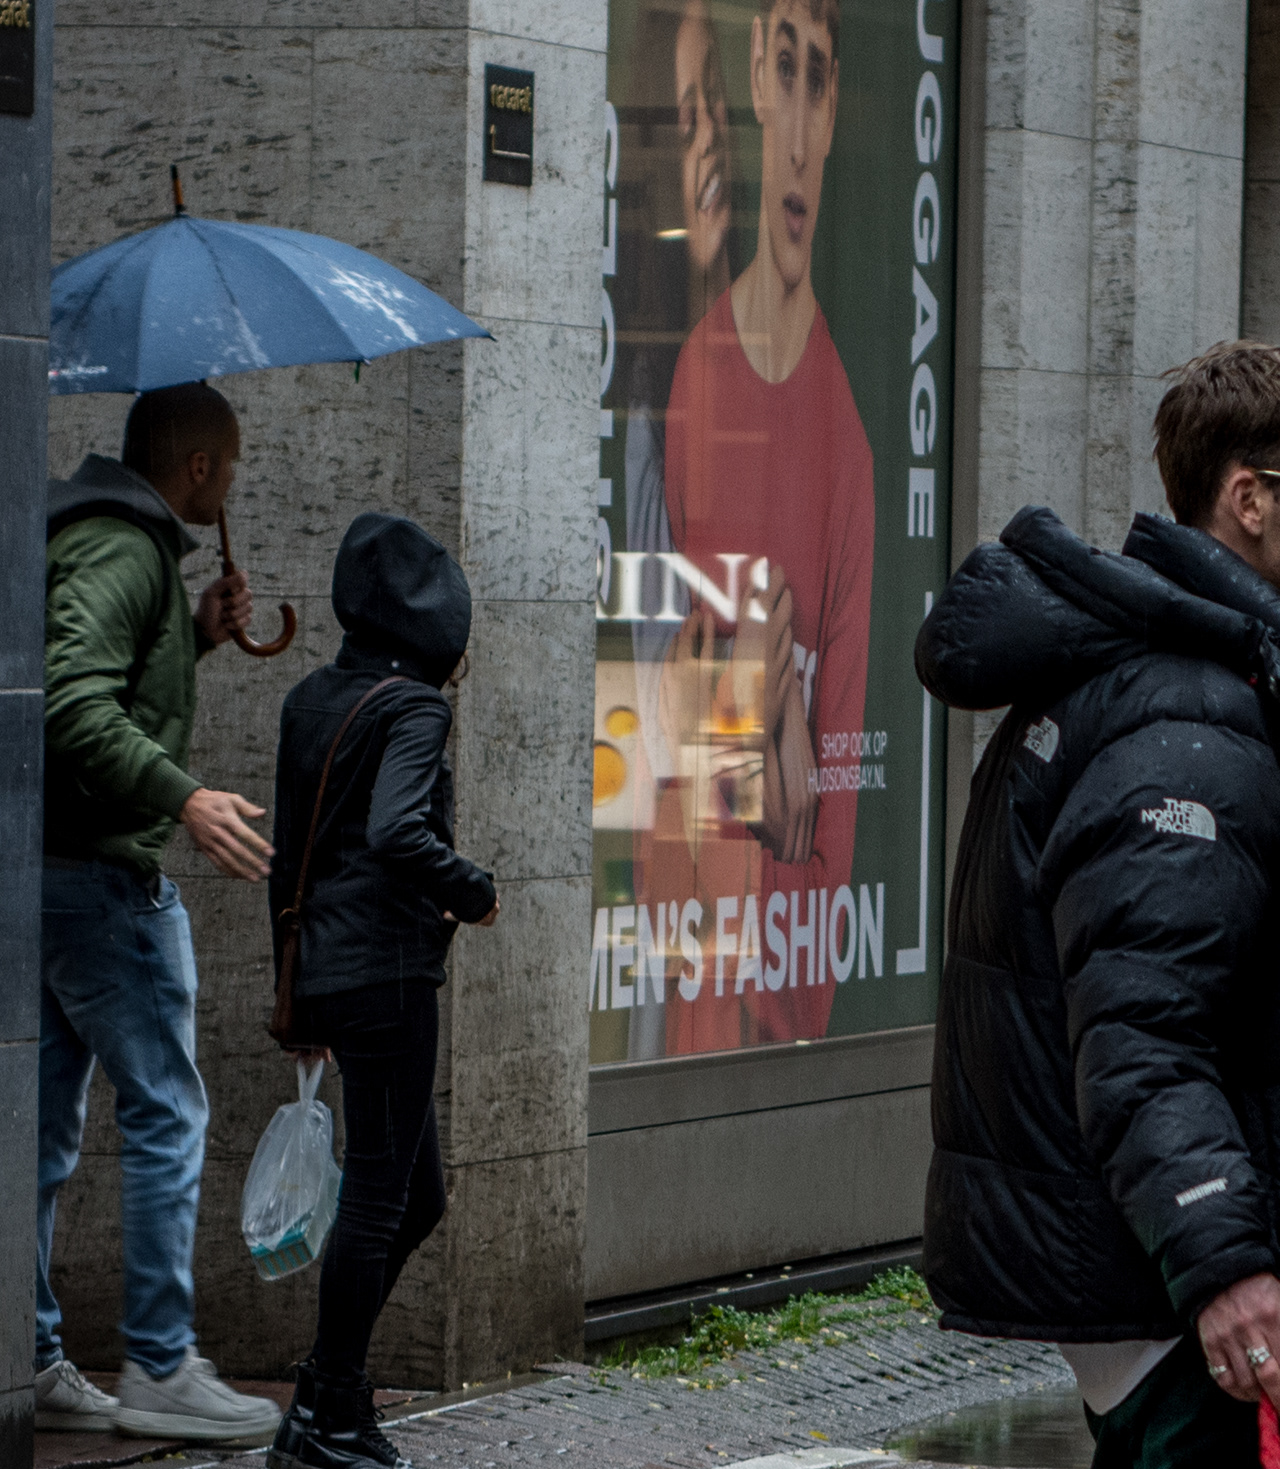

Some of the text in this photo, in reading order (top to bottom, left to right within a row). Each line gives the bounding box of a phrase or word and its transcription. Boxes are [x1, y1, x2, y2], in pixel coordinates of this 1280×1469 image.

[822, 730, 888, 759] SHOP OOK OP
[807, 764, 886, 794] HUDSONSBAY.NL
[1141, 808, 1192, 825] NORTH
[1163, 798, 1195, 813] THE
[1155, 818, 1194, 834] FACE
[715, 882, 885, 997] FASHION
